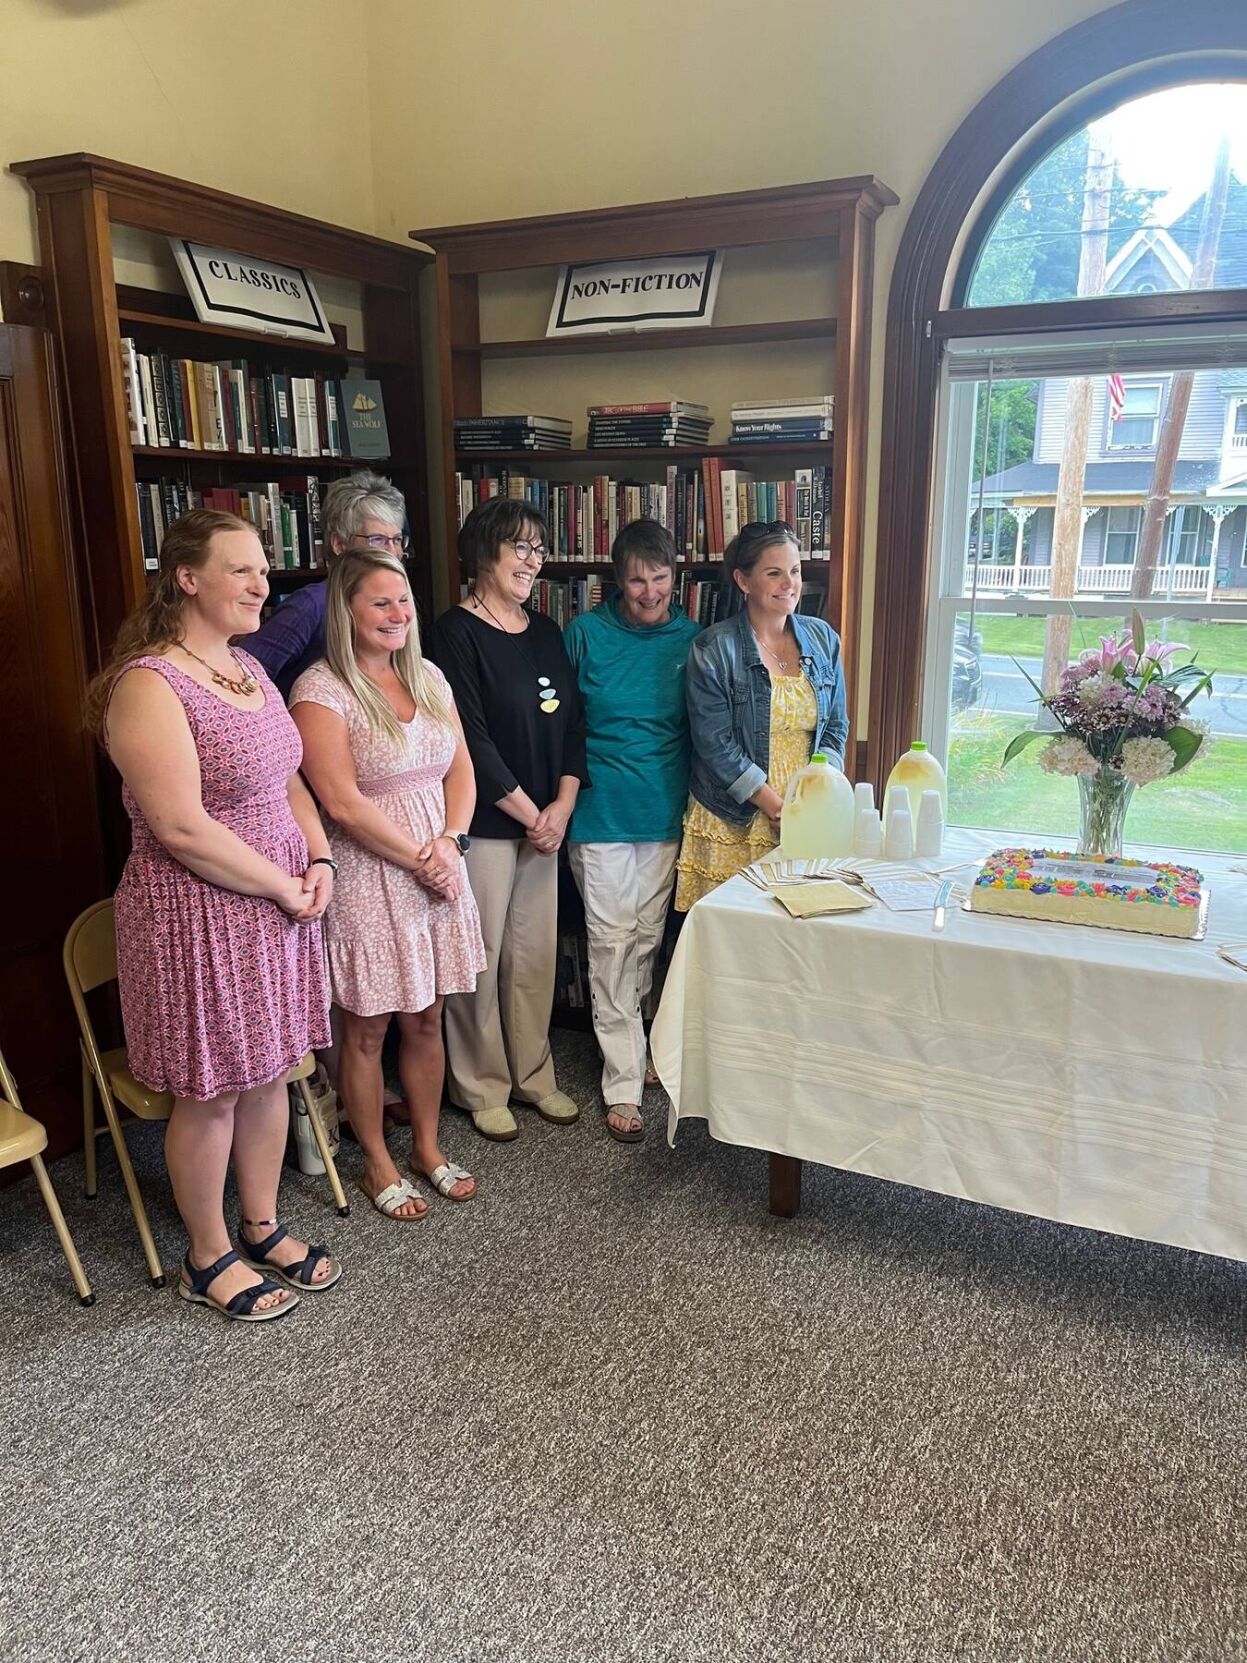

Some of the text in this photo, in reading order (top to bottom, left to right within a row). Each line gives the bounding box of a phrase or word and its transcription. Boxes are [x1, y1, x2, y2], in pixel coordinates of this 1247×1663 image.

[208, 260, 302, 300] CLASSICS
[570, 272, 703, 299] NON-FICTION
[352, 420, 381, 429] SEA WOLF
[735, 423, 782, 433] Know Your Rights
[811, 510, 823, 545] Caste
